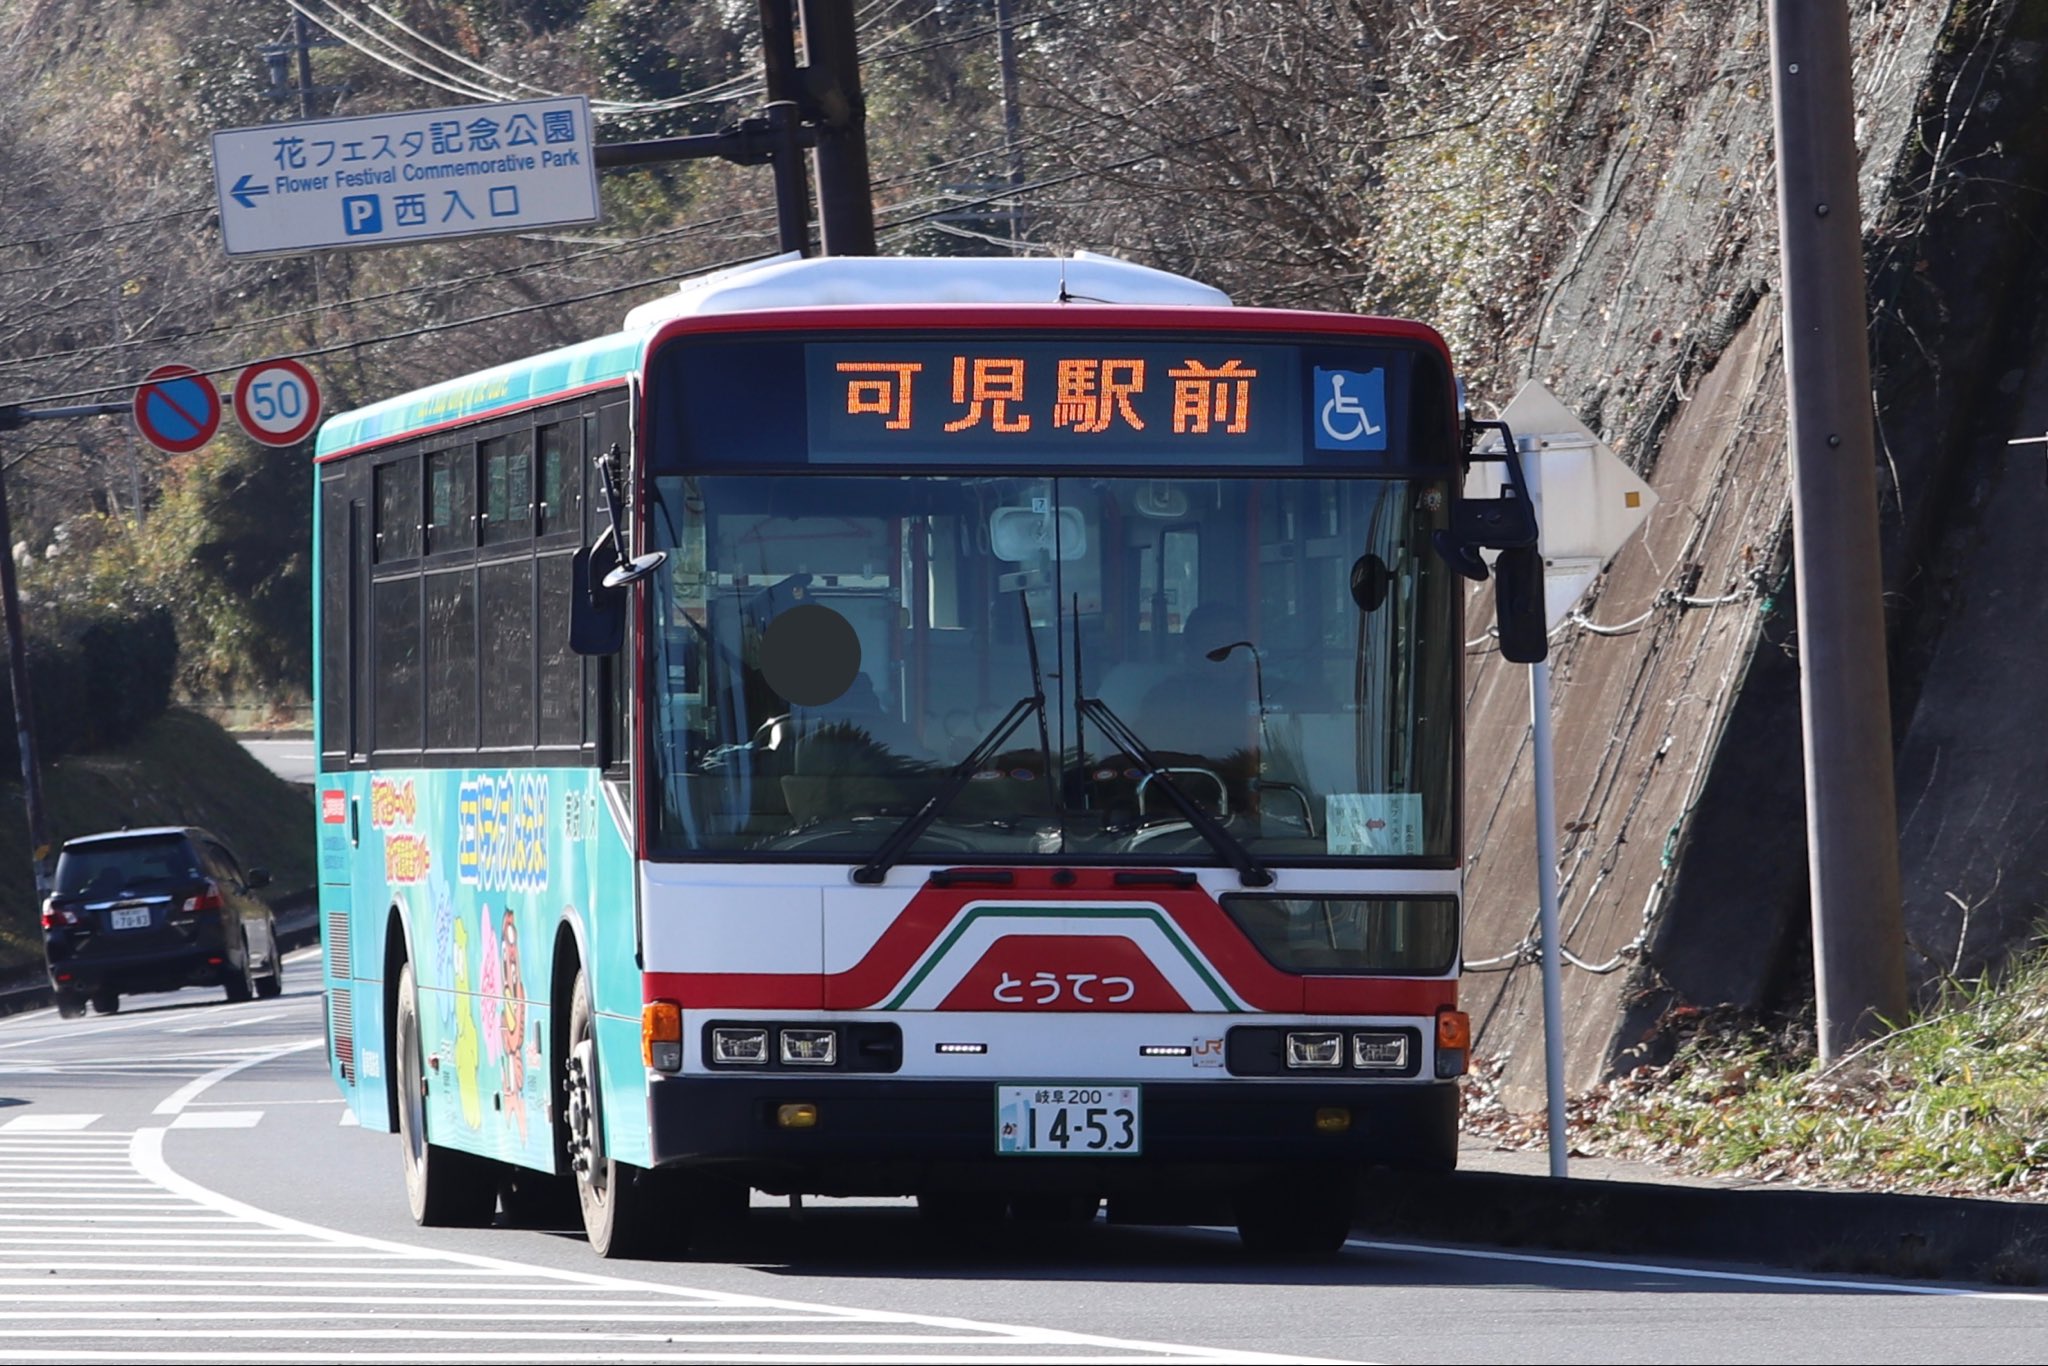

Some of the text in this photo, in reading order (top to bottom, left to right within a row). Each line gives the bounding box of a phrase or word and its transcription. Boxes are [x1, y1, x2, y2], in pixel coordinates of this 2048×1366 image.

[273, 109, 575, 171] 花フェスタ記念公園
[276, 147, 580, 195] Flower Festival Commemorative Park
[349, 185, 519, 230] P 西入口
[252, 381, 301, 421] 50
[836, 356, 1257, 433] 可児駅前
[993, 972, 1134, 1003] とうてつ
[1195, 1040, 1222, 1055] JR
[1002, 1108, 1134, 1149] か 14-53
